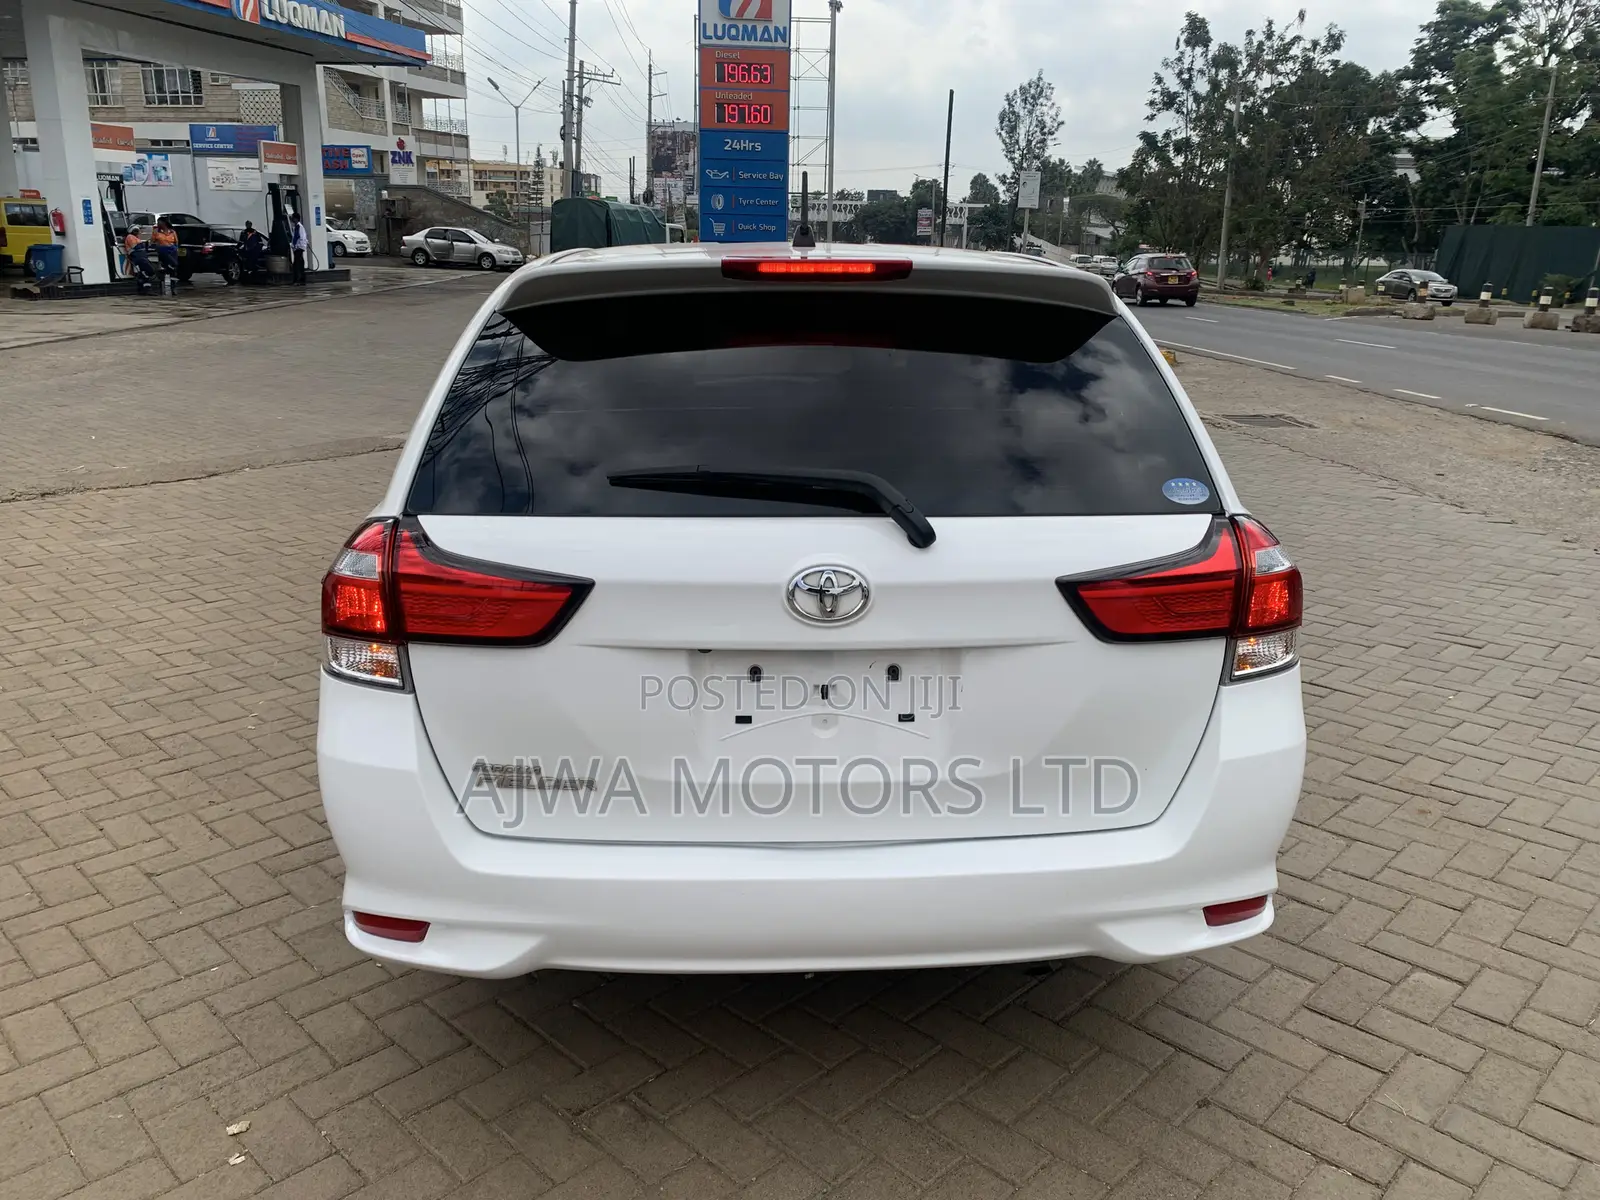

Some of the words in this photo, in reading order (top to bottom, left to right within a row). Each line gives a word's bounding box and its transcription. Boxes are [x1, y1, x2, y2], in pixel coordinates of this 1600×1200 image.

[261, 0, 346, 39] LUQMAN
[702, 22, 787, 43] LUQMAN
[715, 51, 740, 59] Diesel
[723, 63, 771, 84] 196.63
[715, 91, 753, 100] Unleaded
[723, 103, 771, 124] 197.60
[723, 138, 762, 152] 24Hrs
[390, 151, 414, 165] ZNK
[738, 170, 768, 180] Service
[769, 171, 784, 182] Bay
[738, 197, 755, 207] Tyre
[755, 198, 779, 206] Center
[737, 223, 757, 231] Quick
[758, 223, 777, 233] Shop
[475, 773, 598, 791] FIELDER
